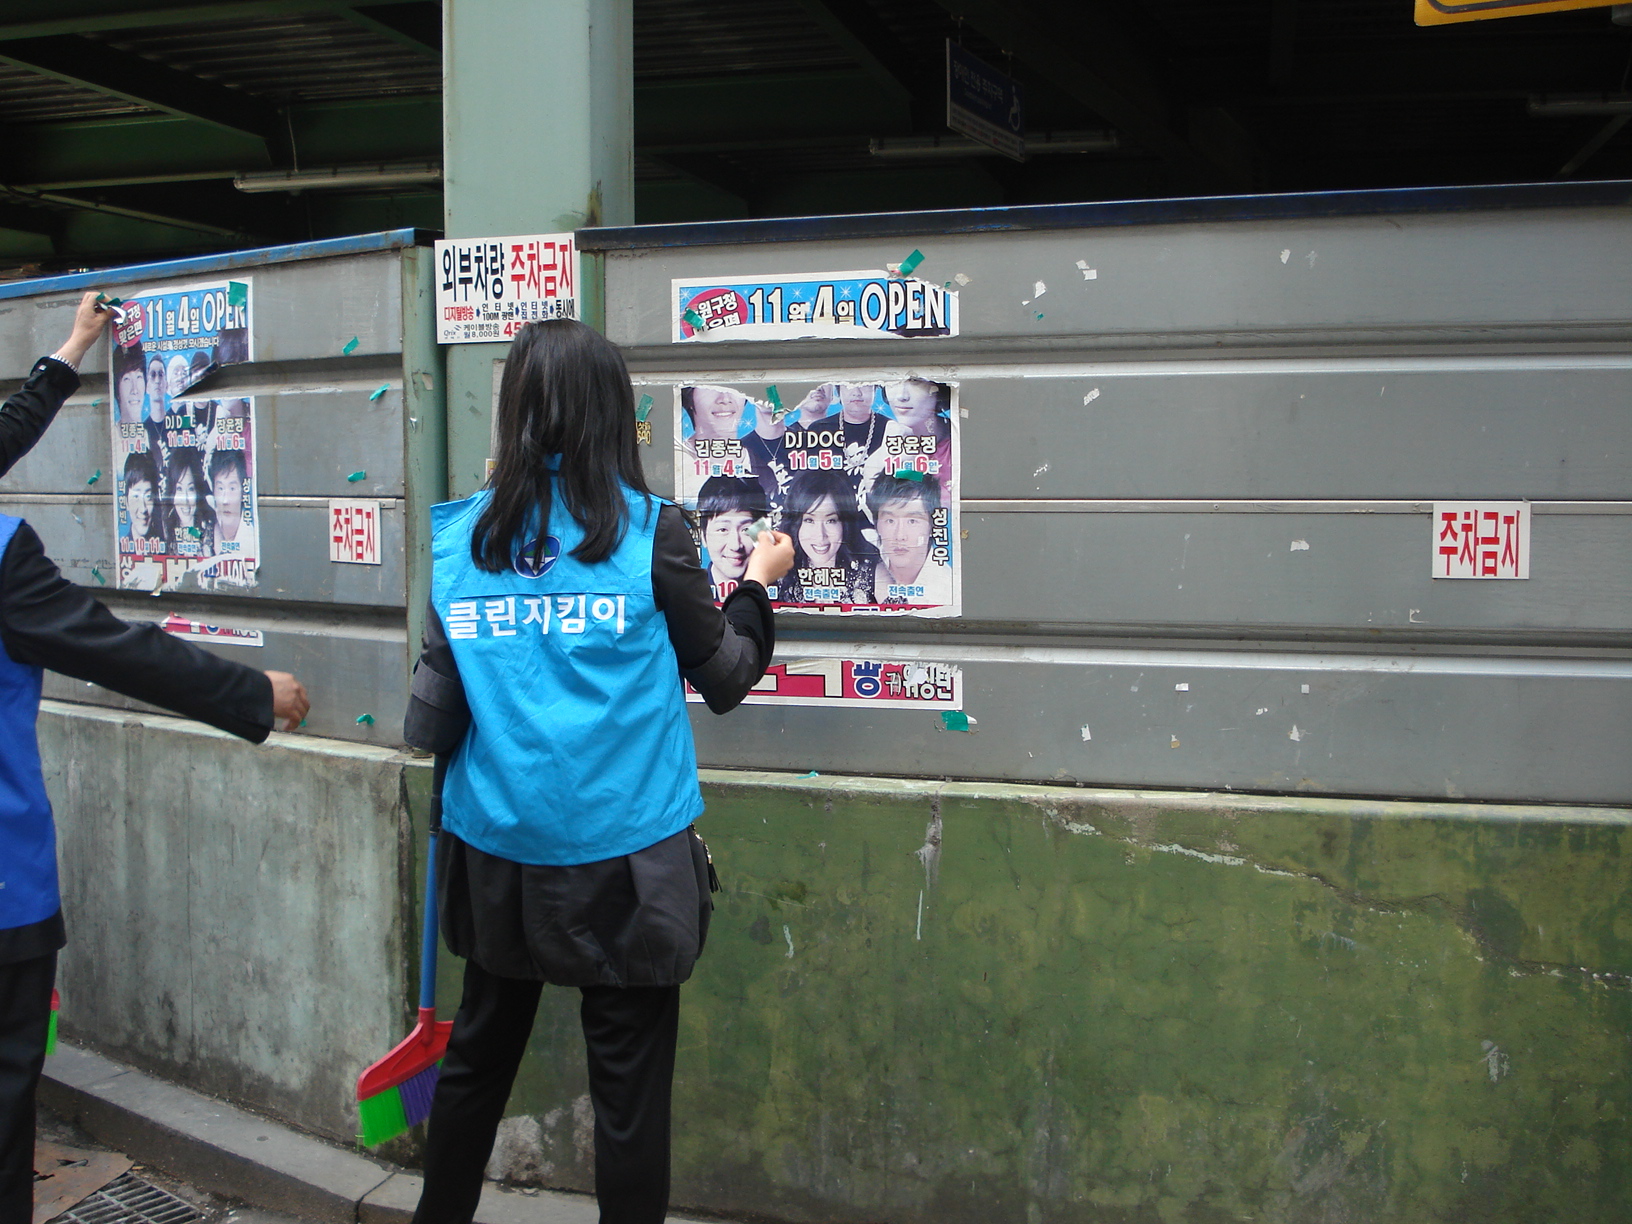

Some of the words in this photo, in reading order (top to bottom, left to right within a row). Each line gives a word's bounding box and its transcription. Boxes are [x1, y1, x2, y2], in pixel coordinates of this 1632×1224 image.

[442, 243, 505, 302] 외부차량
[510, 239, 574, 300] 주차금지
[444, 305, 474, 321] 디지털방송
[690, 290, 738, 320] 원구청
[860, 281, 946, 331] OPEN
[146, 299, 175, 339] 11월
[177, 295, 200, 335] 4일
[482, 312, 500, 321] 100M
[120, 422, 145, 438] 김종국
[217, 417, 244, 434] 장윤정
[695, 438, 742, 458] 김종국
[785, 431, 803, 449] DJ
[807, 430, 845, 449] DOC
[886, 435, 937, 455] 장윤정
[242, 478, 252, 526] 성진우
[333, 506, 376, 562] 주차금지
[932, 508, 949, 566] 성진우
[1439, 509, 1520, 577] 주차금지
[798, 567, 846, 586] 한혜진
[804, 587, 840, 599] 전속출연
[888, 585, 924, 597] 전속출연
[445, 594, 626, 639] 클린지킴이
